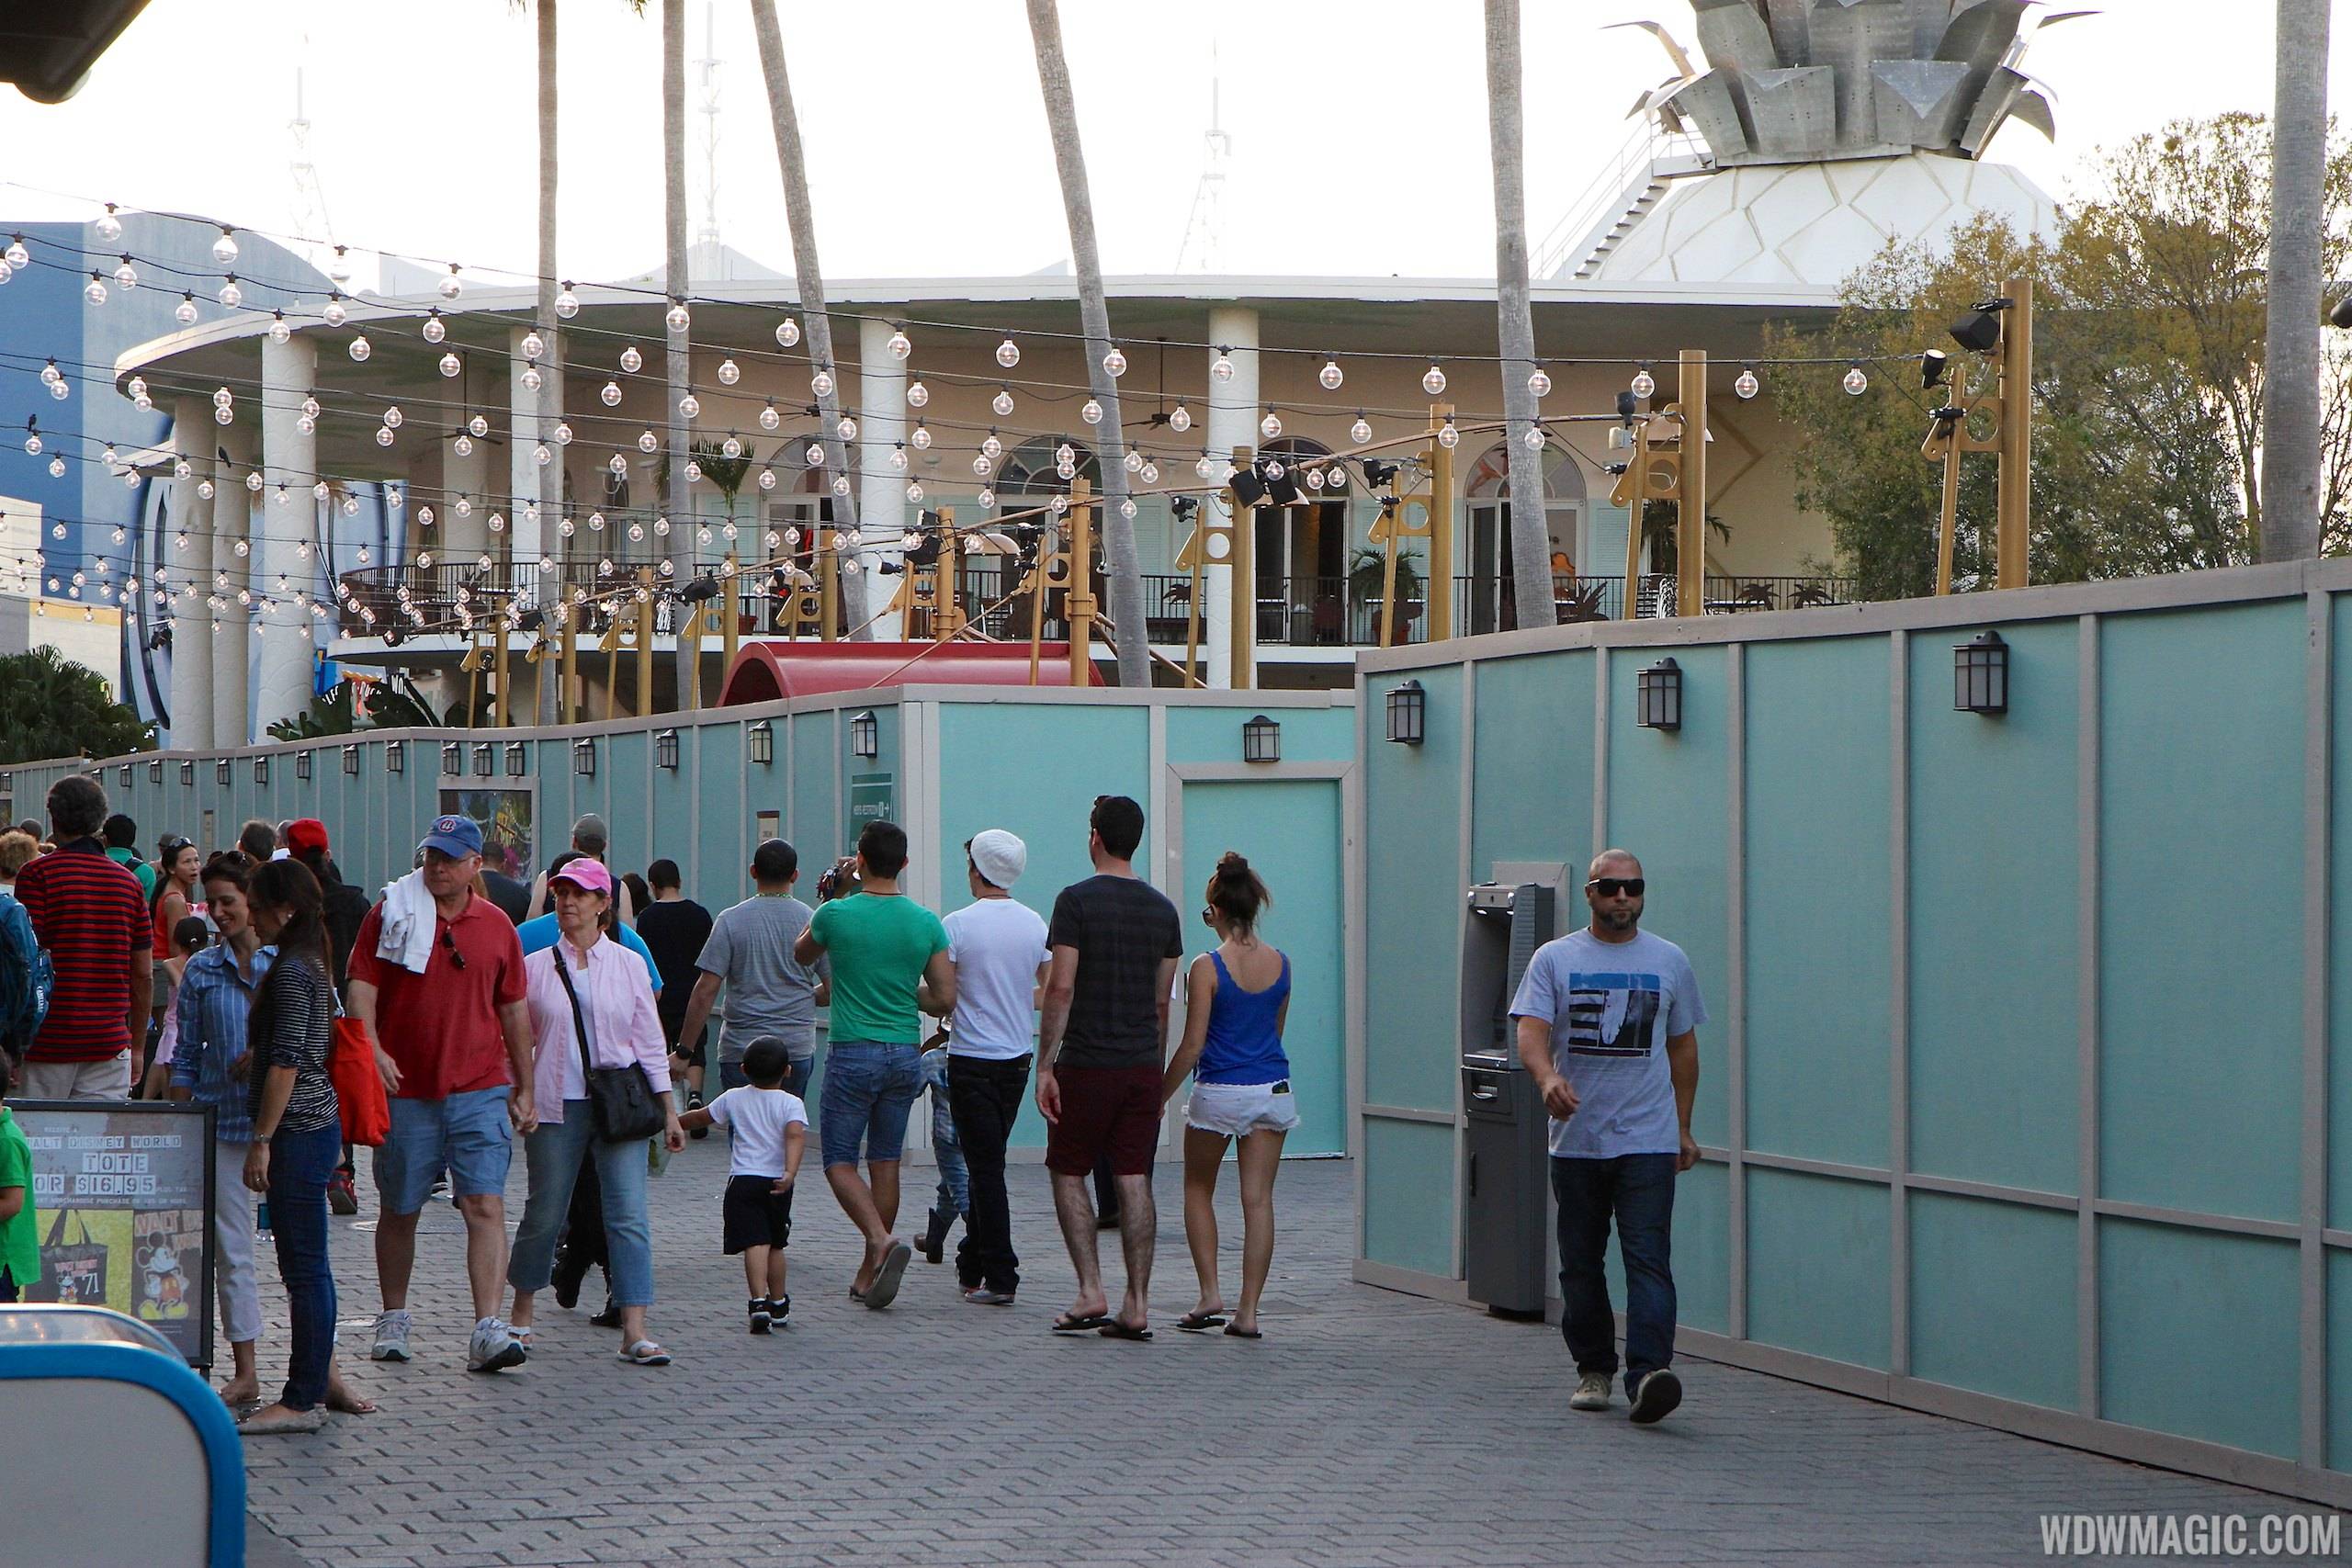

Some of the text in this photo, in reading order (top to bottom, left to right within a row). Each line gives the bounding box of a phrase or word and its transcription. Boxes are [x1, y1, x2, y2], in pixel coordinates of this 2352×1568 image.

[69, 1136, 123, 1147] DISNEY
[132, 1136, 181, 1147] WORLD
[86, 1155, 148, 1172] TOTE
[34, 1175, 154, 1194] OR $16.95
